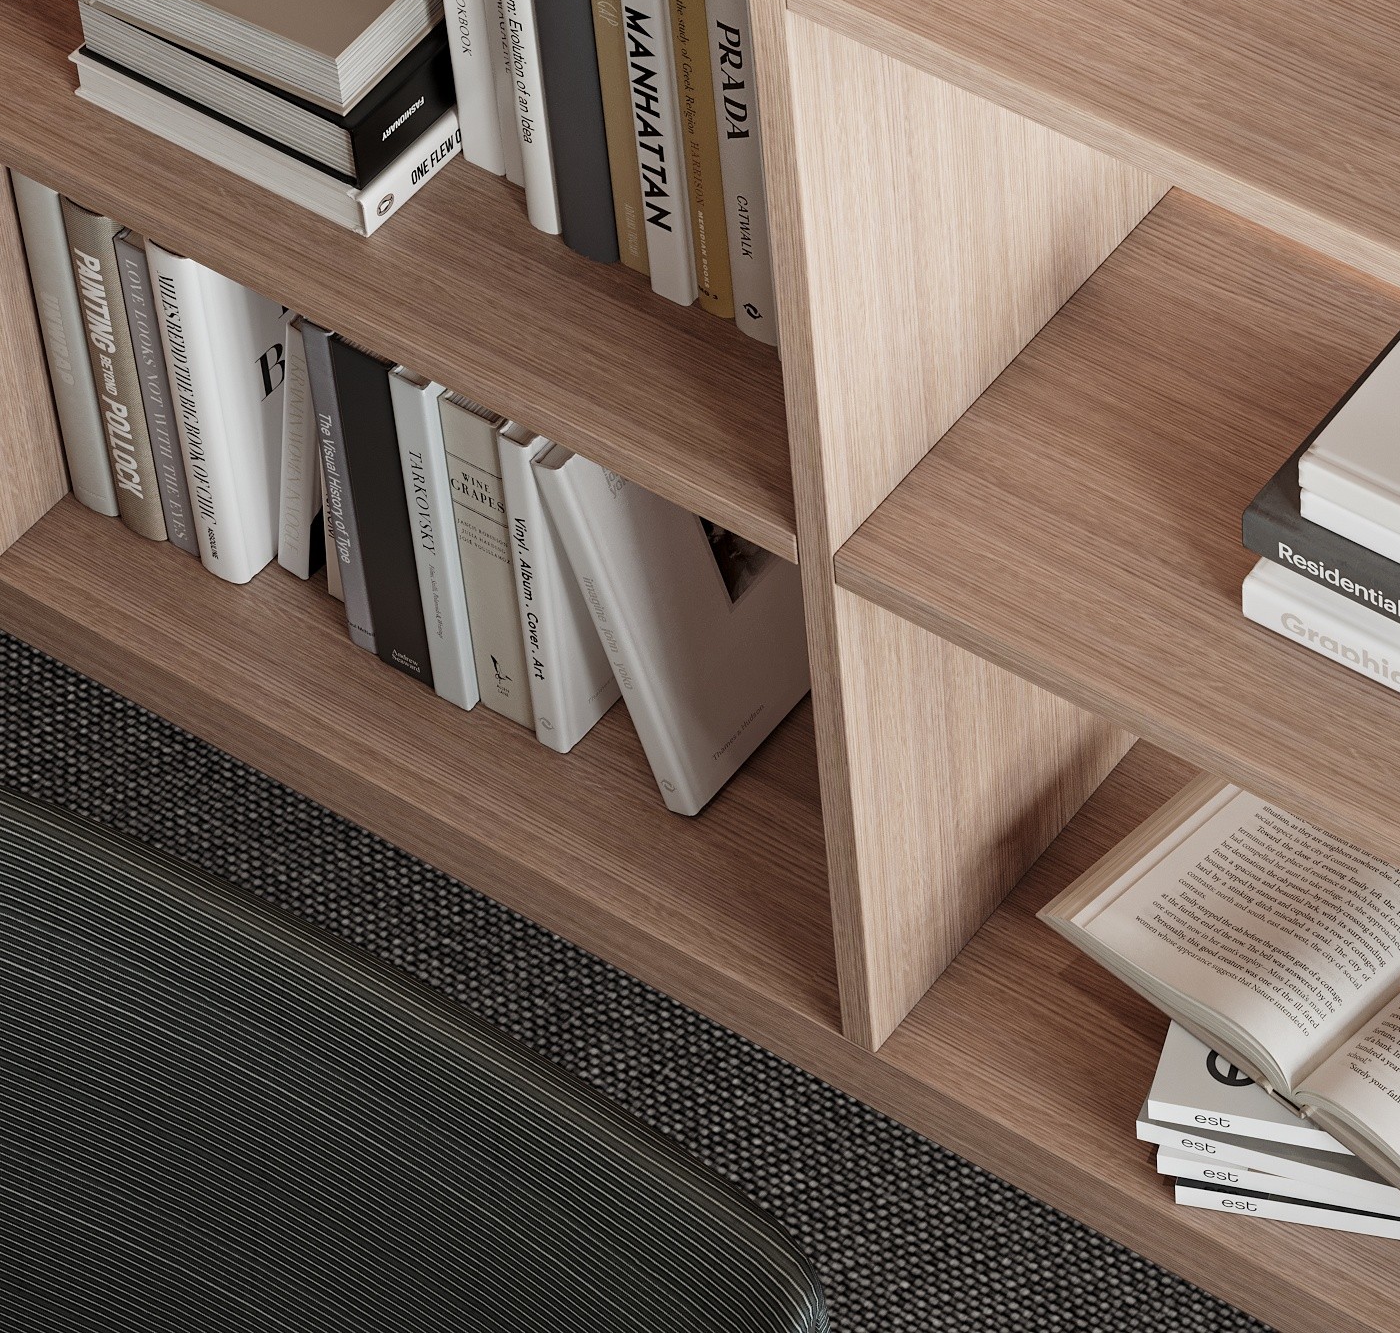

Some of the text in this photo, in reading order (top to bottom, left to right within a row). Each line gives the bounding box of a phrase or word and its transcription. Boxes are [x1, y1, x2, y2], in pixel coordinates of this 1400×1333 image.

[676, 0, 686, 14] the
[677, 14, 690, 44] study
[509, 20, 525, 78] Evolution
[516, 79, 531, 97] of
[716, 19, 750, 140] PRADA
[381, 96, 425, 141] FASHIONARY
[518, 96, 529, 113] an
[624, 5, 673, 233] MANHATTAN
[521, 114, 534, 144] Idea
[410, 141, 455, 185] ONE FLEW
[736, 194, 753, 259] CATWALK
[74, 247, 144, 499] PAINTING BEYOND POLLOCK
[174, 363, 194, 396] THE
[125, 259, 188, 541] LOVE LOOKS NOT WITH THE EYES
[179, 394, 199, 424] BIG
[184, 421, 205, 461] BOOK
[319, 413, 332, 436] The
[323, 439, 336, 476] Visual
[329, 474, 343, 520] History
[450, 477, 506, 514] GRAPES
[461, 471, 491, 494] WINE
[196, 486, 217, 525] CHIC
[408, 450, 436, 556] TARKOVSKY
[336, 519, 350, 537] of
[337, 536, 351, 564] Type
[519, 558, 534, 601] Album
[532, 656, 545, 681] Art
[582, 576, 608, 623] imagine
[600, 626, 620, 655] john
[614, 661, 634, 690] yoko
[1135, 915, 1275, 1004] women Nature
[1194, 1114, 1231, 1128] est
[1181, 1138, 1217, 1155] est
[1203, 1169, 1239, 1183] est
[1221, 1199, 1258, 1212] est
